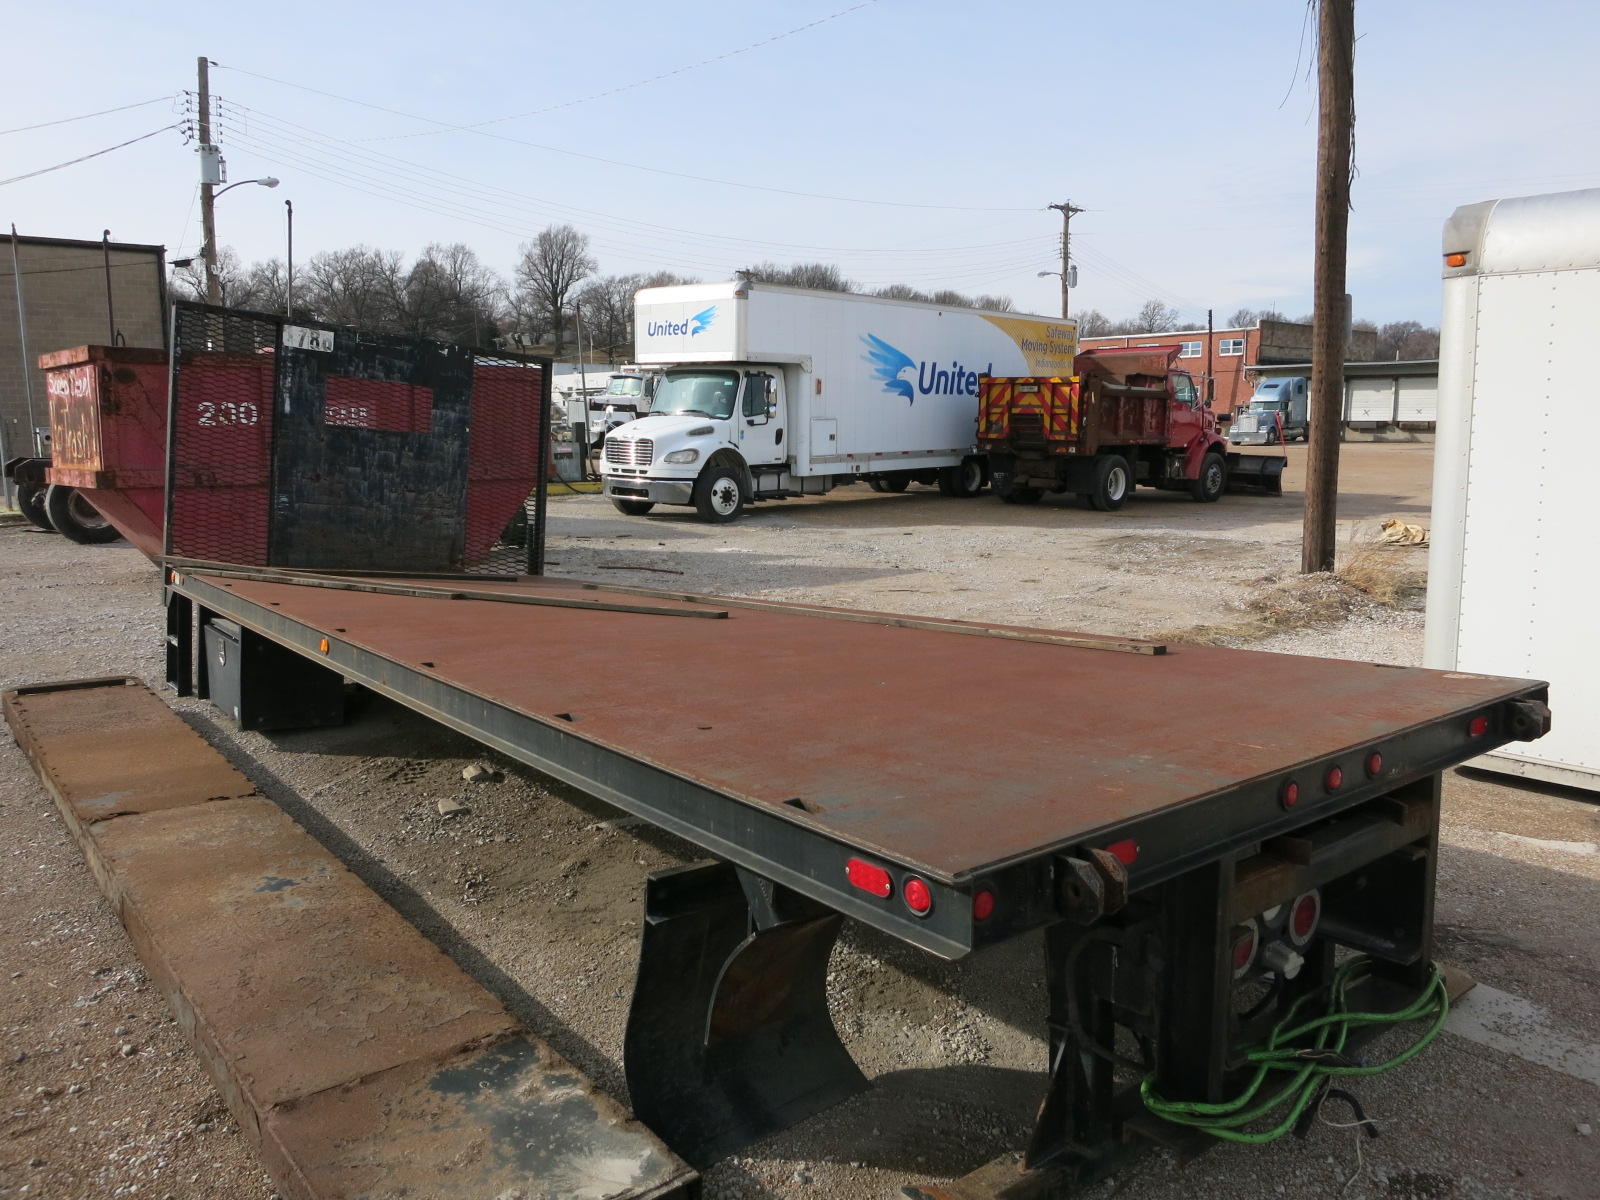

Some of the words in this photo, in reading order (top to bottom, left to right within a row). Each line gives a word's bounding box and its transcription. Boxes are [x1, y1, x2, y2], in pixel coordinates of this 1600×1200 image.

[647, 318, 689, 337] United
[1046, 326, 1075, 342] Safeway
[1021, 338, 1048, 354] Moving
[1049, 341, 1075, 355] System
[918, 361, 993, 396] Unite
[197, 402, 258, 425] 200
[325, 406, 368, 419] CKER
